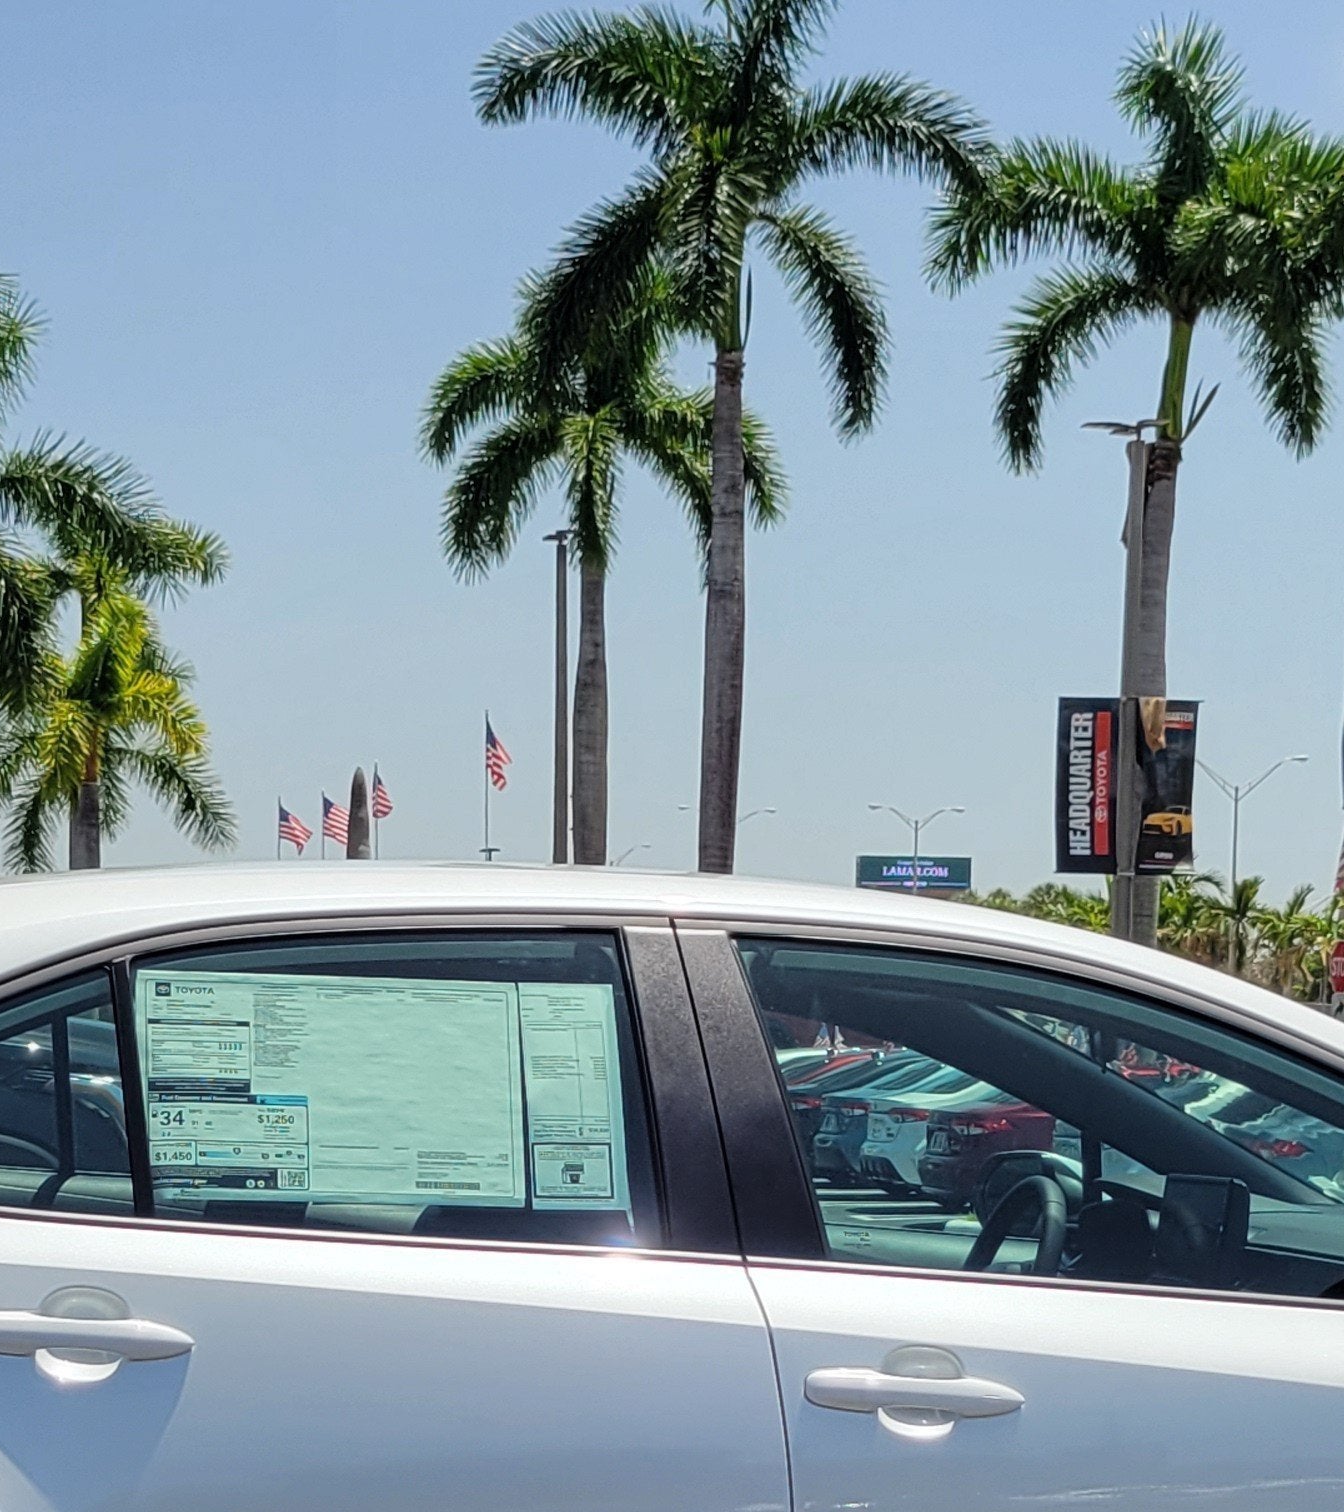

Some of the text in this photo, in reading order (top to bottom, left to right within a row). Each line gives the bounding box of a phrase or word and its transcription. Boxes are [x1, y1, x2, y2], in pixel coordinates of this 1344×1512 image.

[1068, 712, 1094, 856] HEADQUARTER
[1096, 750, 1108, 804] TOYOTA
[175, 985, 215, 995] TOYOTA
[160, 1110, 185, 1126] 34
[257, 1114, 295, 1125] $1,250
[155, 1151, 193, 1163] $1,450
